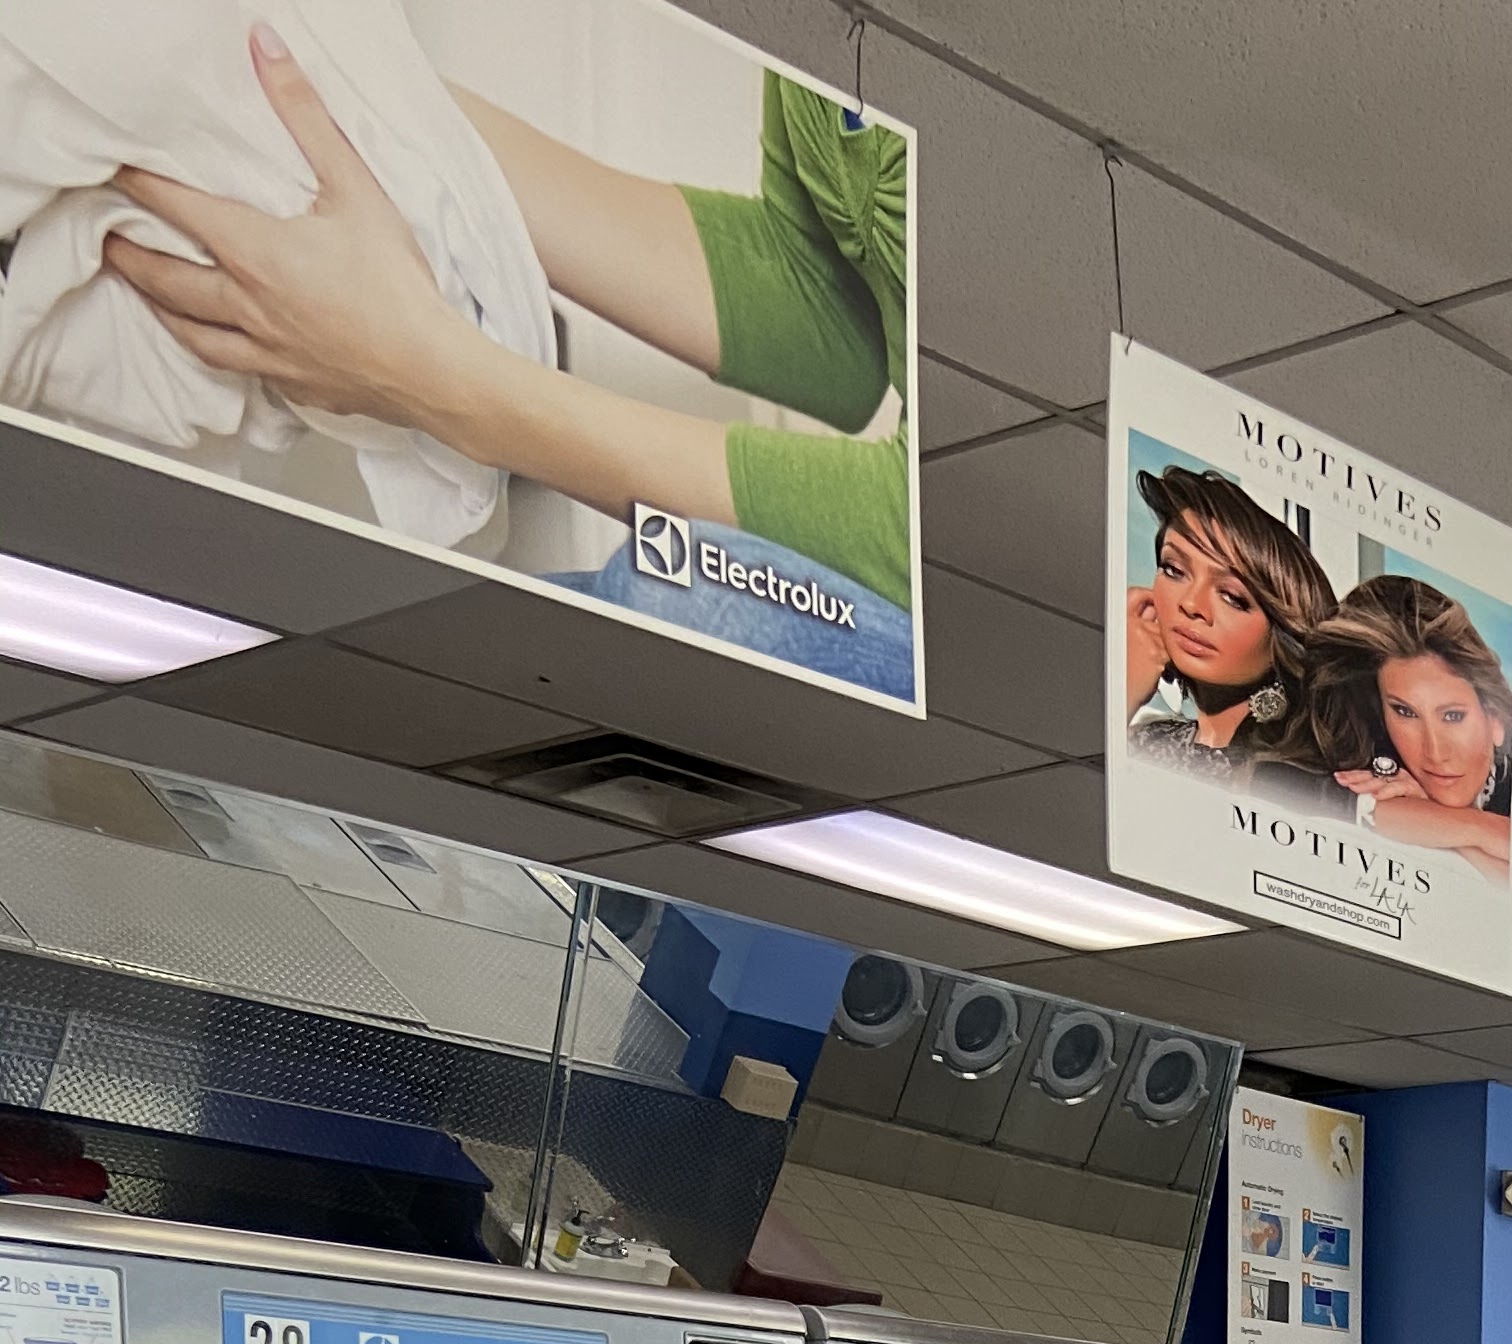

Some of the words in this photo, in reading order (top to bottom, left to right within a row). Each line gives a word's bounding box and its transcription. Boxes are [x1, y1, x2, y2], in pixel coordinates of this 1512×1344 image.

[1237, 410, 1442, 532] MOTIVES
[1245, 450, 1315, 491] LOREN
[1332, 491, 1433, 546] RIDINGER
[699, 541, 857, 629] Electrolux
[1230, 804, 1432, 894] MOTIVES
[1266, 881, 1391, 931] washdryandshop.com
[1241, 1128, 1304, 1159] instructions
[1242, 1108, 1277, 1131] Dryer
[14, 1277, 41, 1295] lbs
